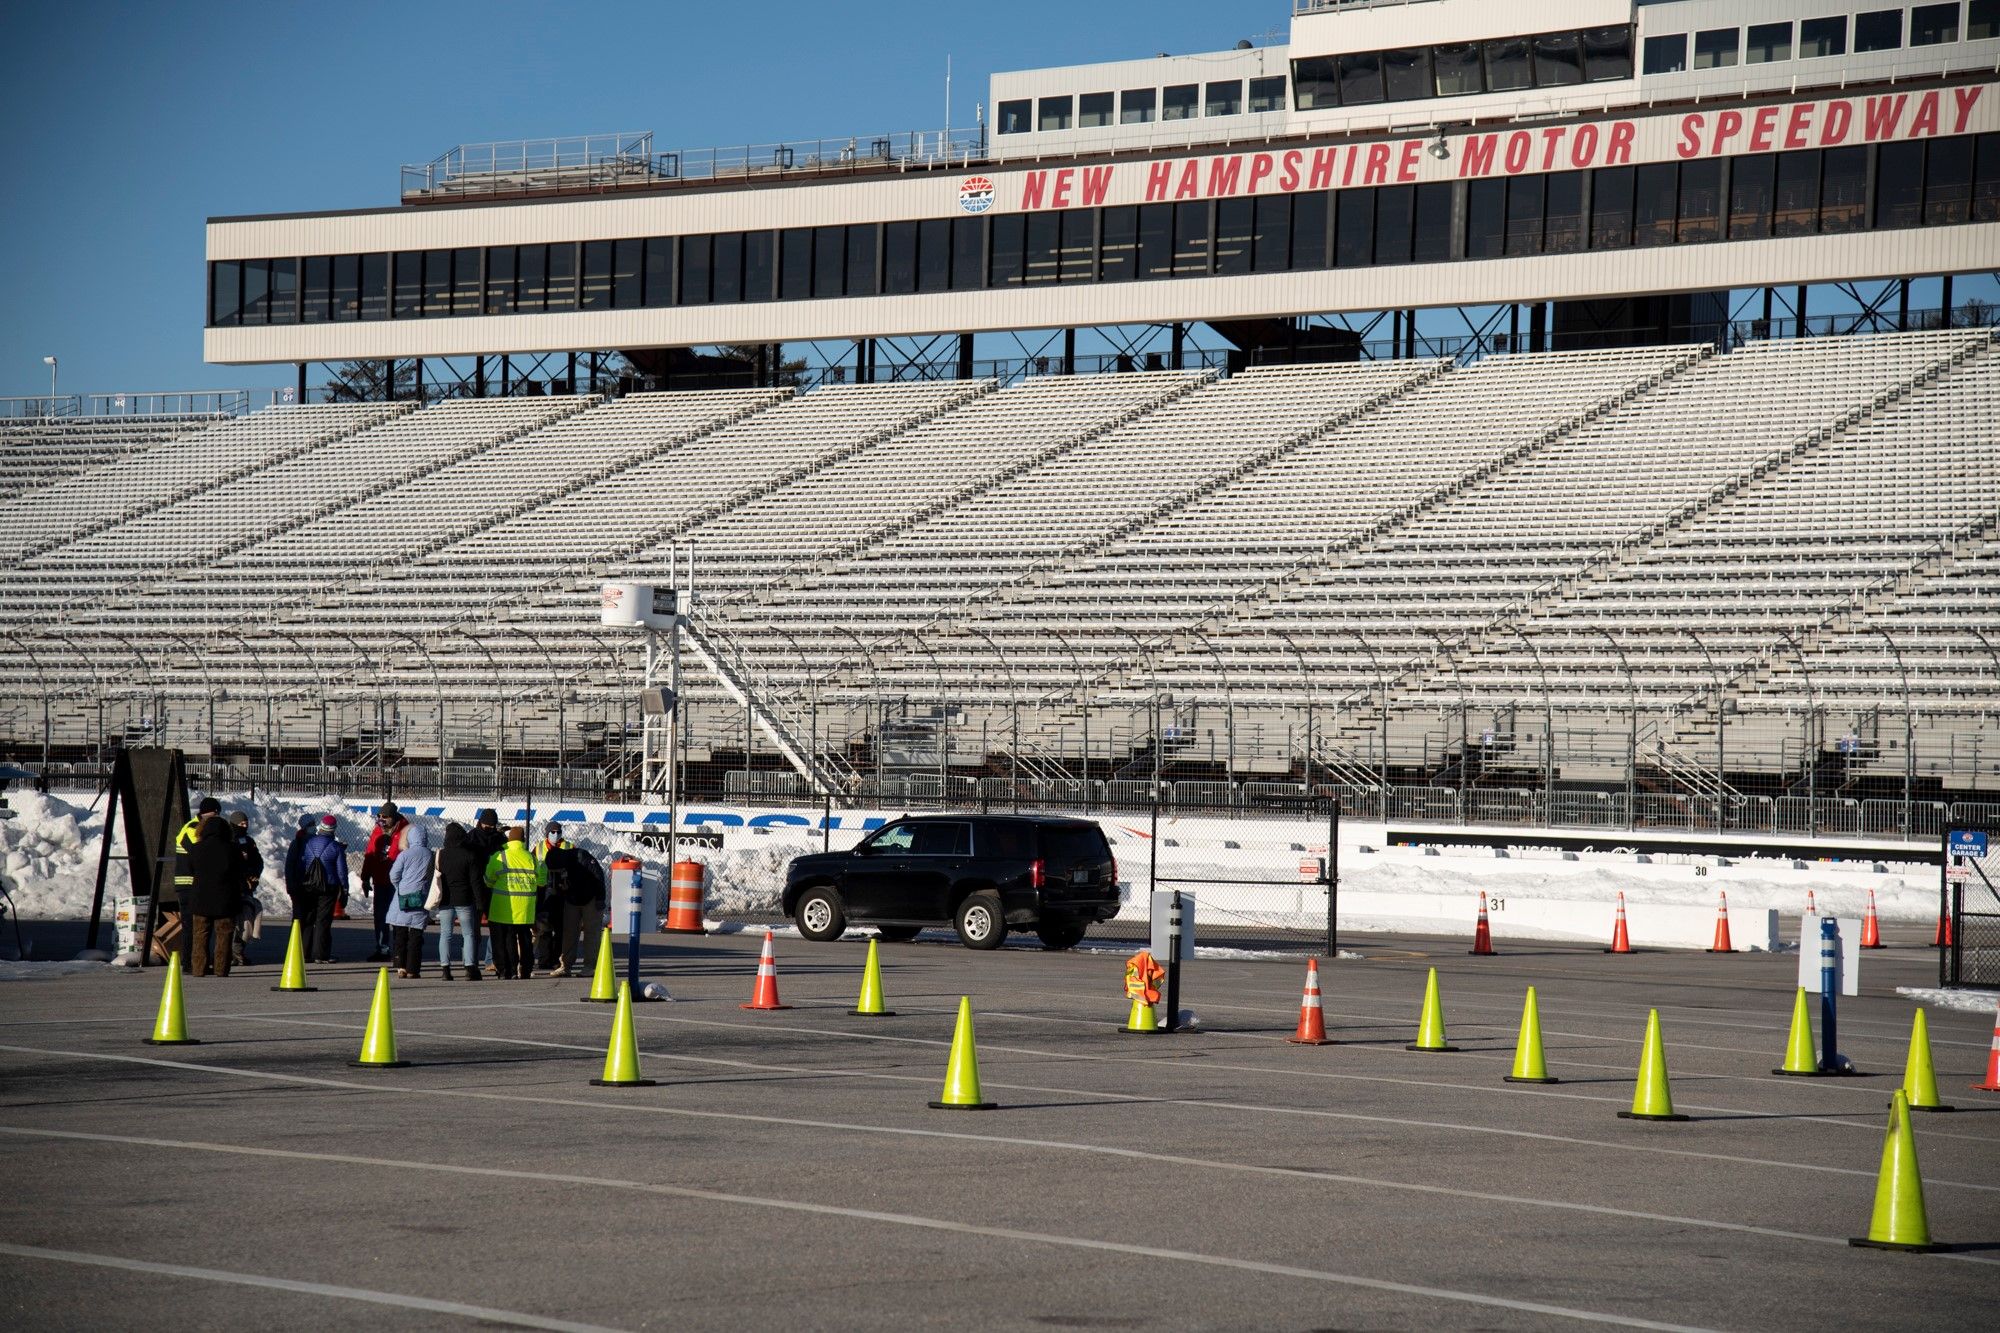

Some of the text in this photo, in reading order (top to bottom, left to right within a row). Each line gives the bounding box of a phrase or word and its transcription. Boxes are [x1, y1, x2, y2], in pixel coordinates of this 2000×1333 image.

[1021, 86, 1984, 210] NEW HAMPSHIRE MOTOR SPEEDWAY
[1695, 866, 1707, 877] 30
[1490, 898, 1505, 911] 31
